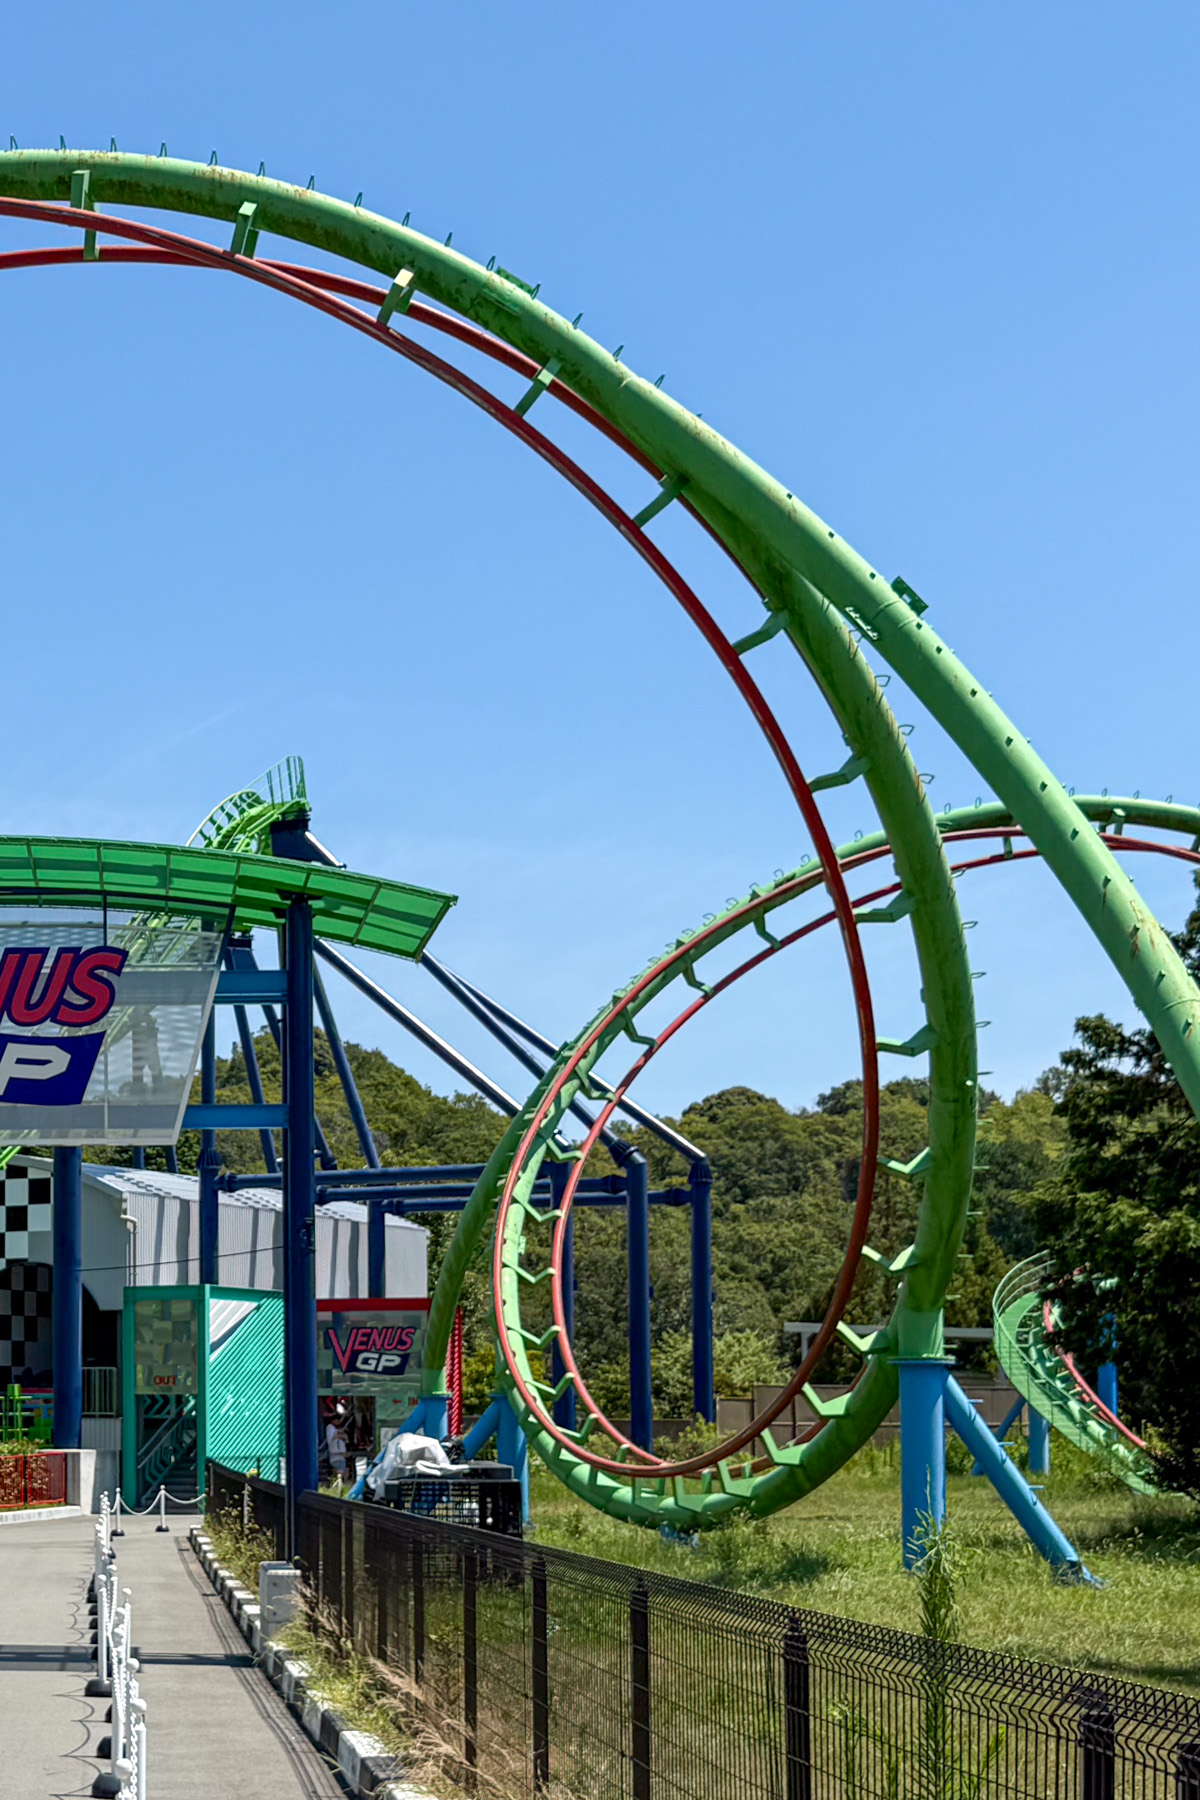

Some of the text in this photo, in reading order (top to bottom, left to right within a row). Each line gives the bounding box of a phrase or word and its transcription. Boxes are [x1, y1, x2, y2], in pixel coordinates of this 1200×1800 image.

[327, 1327, 416, 1372] VENUS
[355, 1351, 402, 1372] GP
[153, 1375, 177, 1386] OUT
